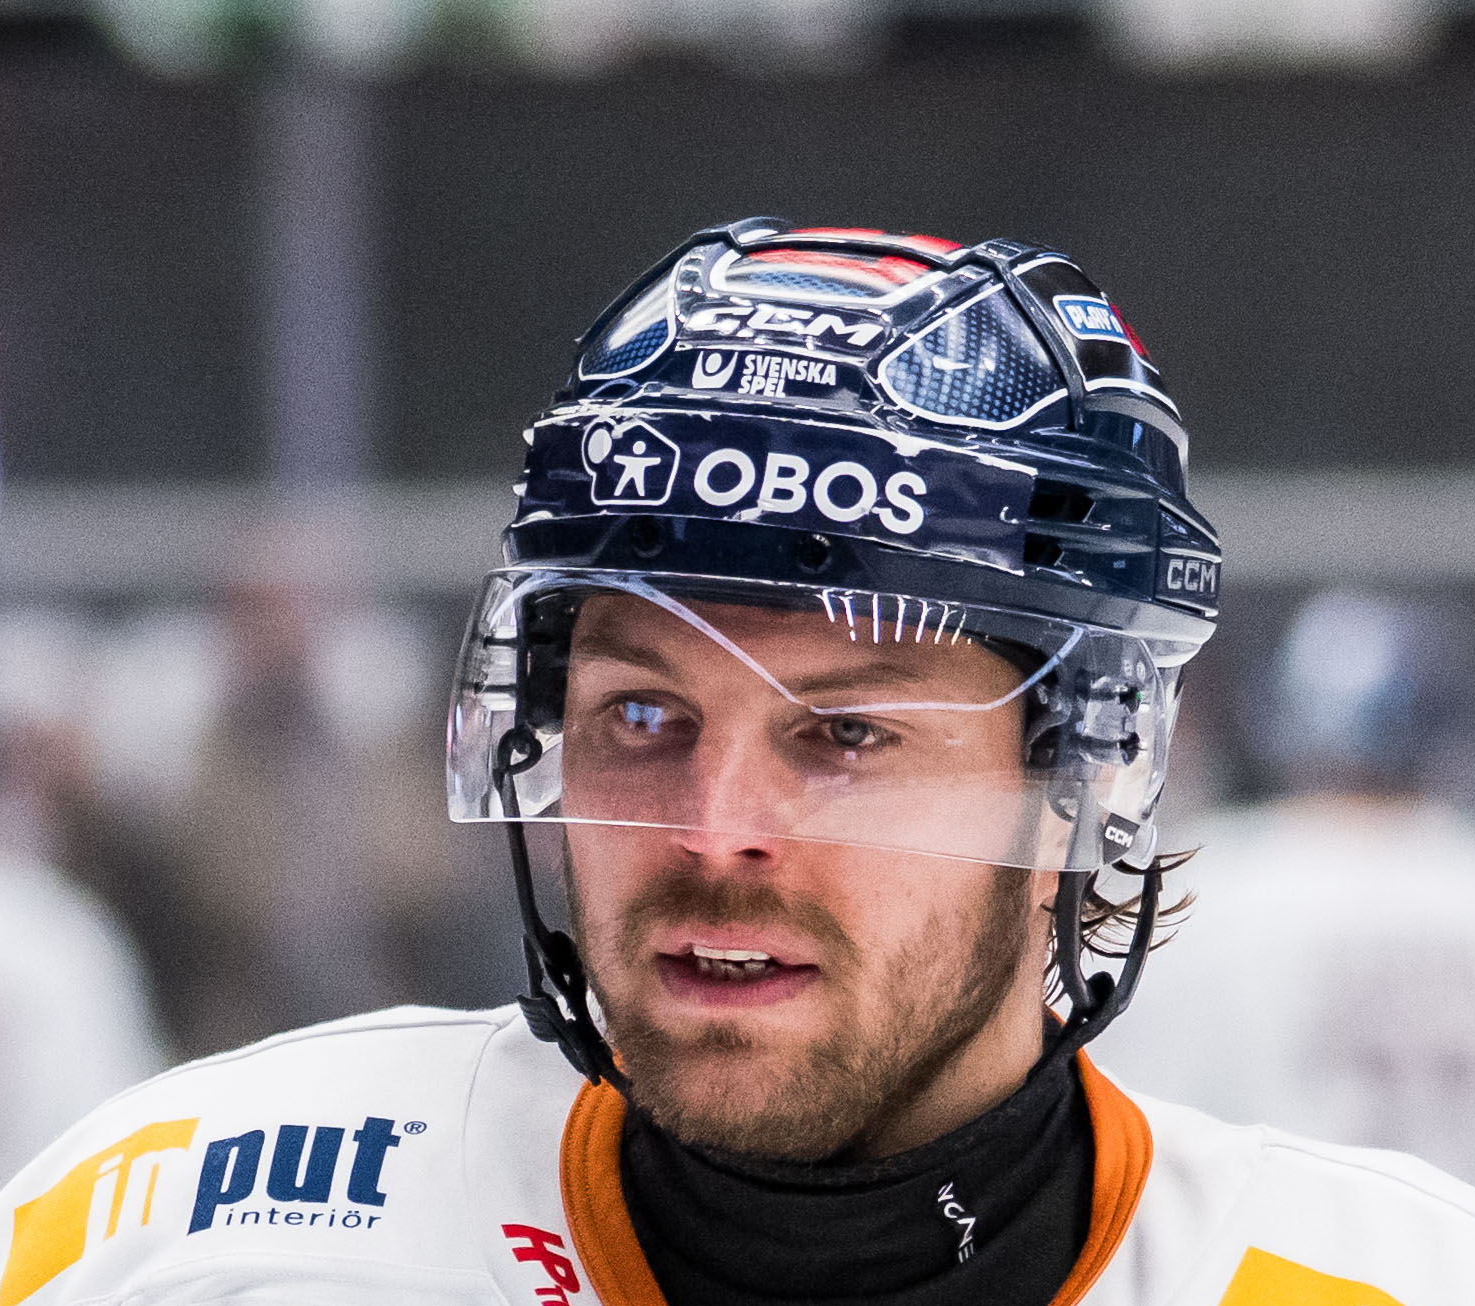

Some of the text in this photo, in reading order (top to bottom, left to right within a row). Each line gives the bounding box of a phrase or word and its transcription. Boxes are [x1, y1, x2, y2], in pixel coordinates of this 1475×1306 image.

[737, 374, 787, 398] SPEL
[742, 354, 837, 386] SVENSKA
[694, 447, 928, 534] OBOS
[1167, 558, 1216, 593] CCM
[225, 1207, 381, 1231] interiör
